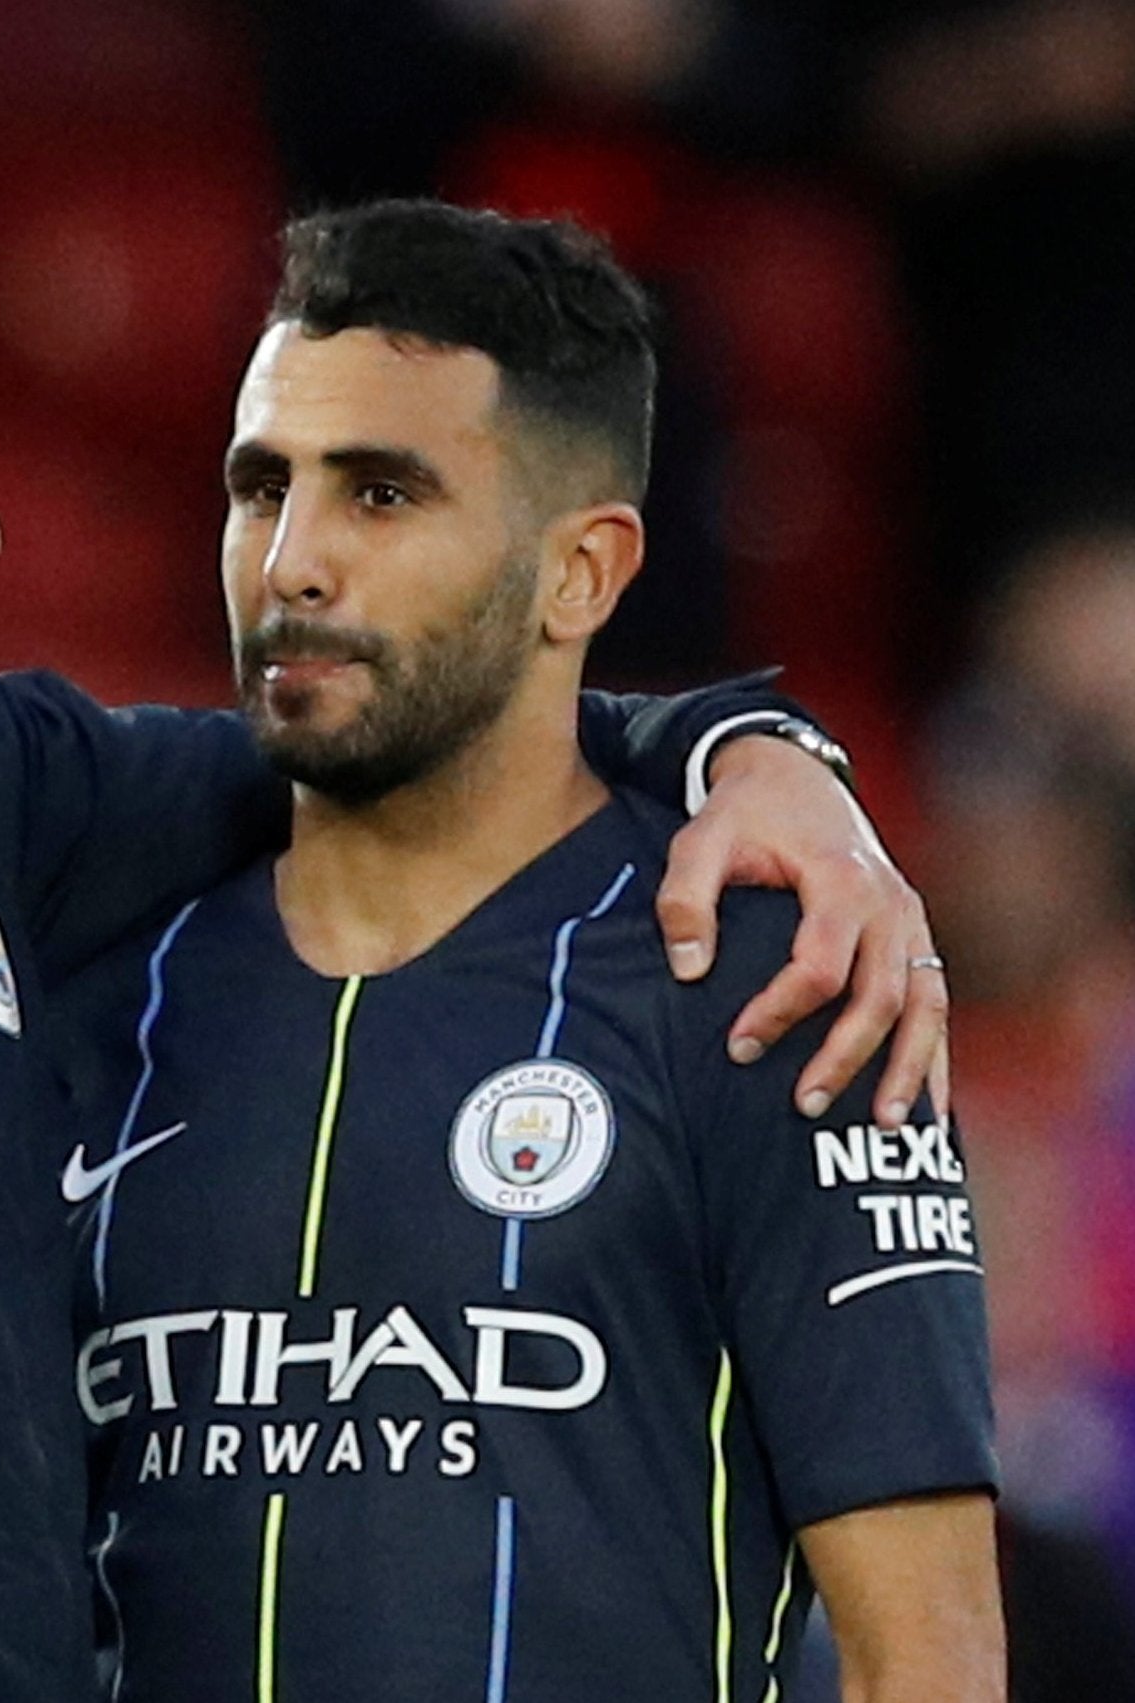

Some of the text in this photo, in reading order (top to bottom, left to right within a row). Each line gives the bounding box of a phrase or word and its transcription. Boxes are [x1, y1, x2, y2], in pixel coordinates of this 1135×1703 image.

[475, 1069, 599, 1116] MANCHESTER
[496, 1190, 542, 1207] CITY
[858, 1196, 974, 1255] TIRE
[77, 1305, 606, 1425] ETIHAD
[138, 1418, 477, 1483] AIRWAYS
